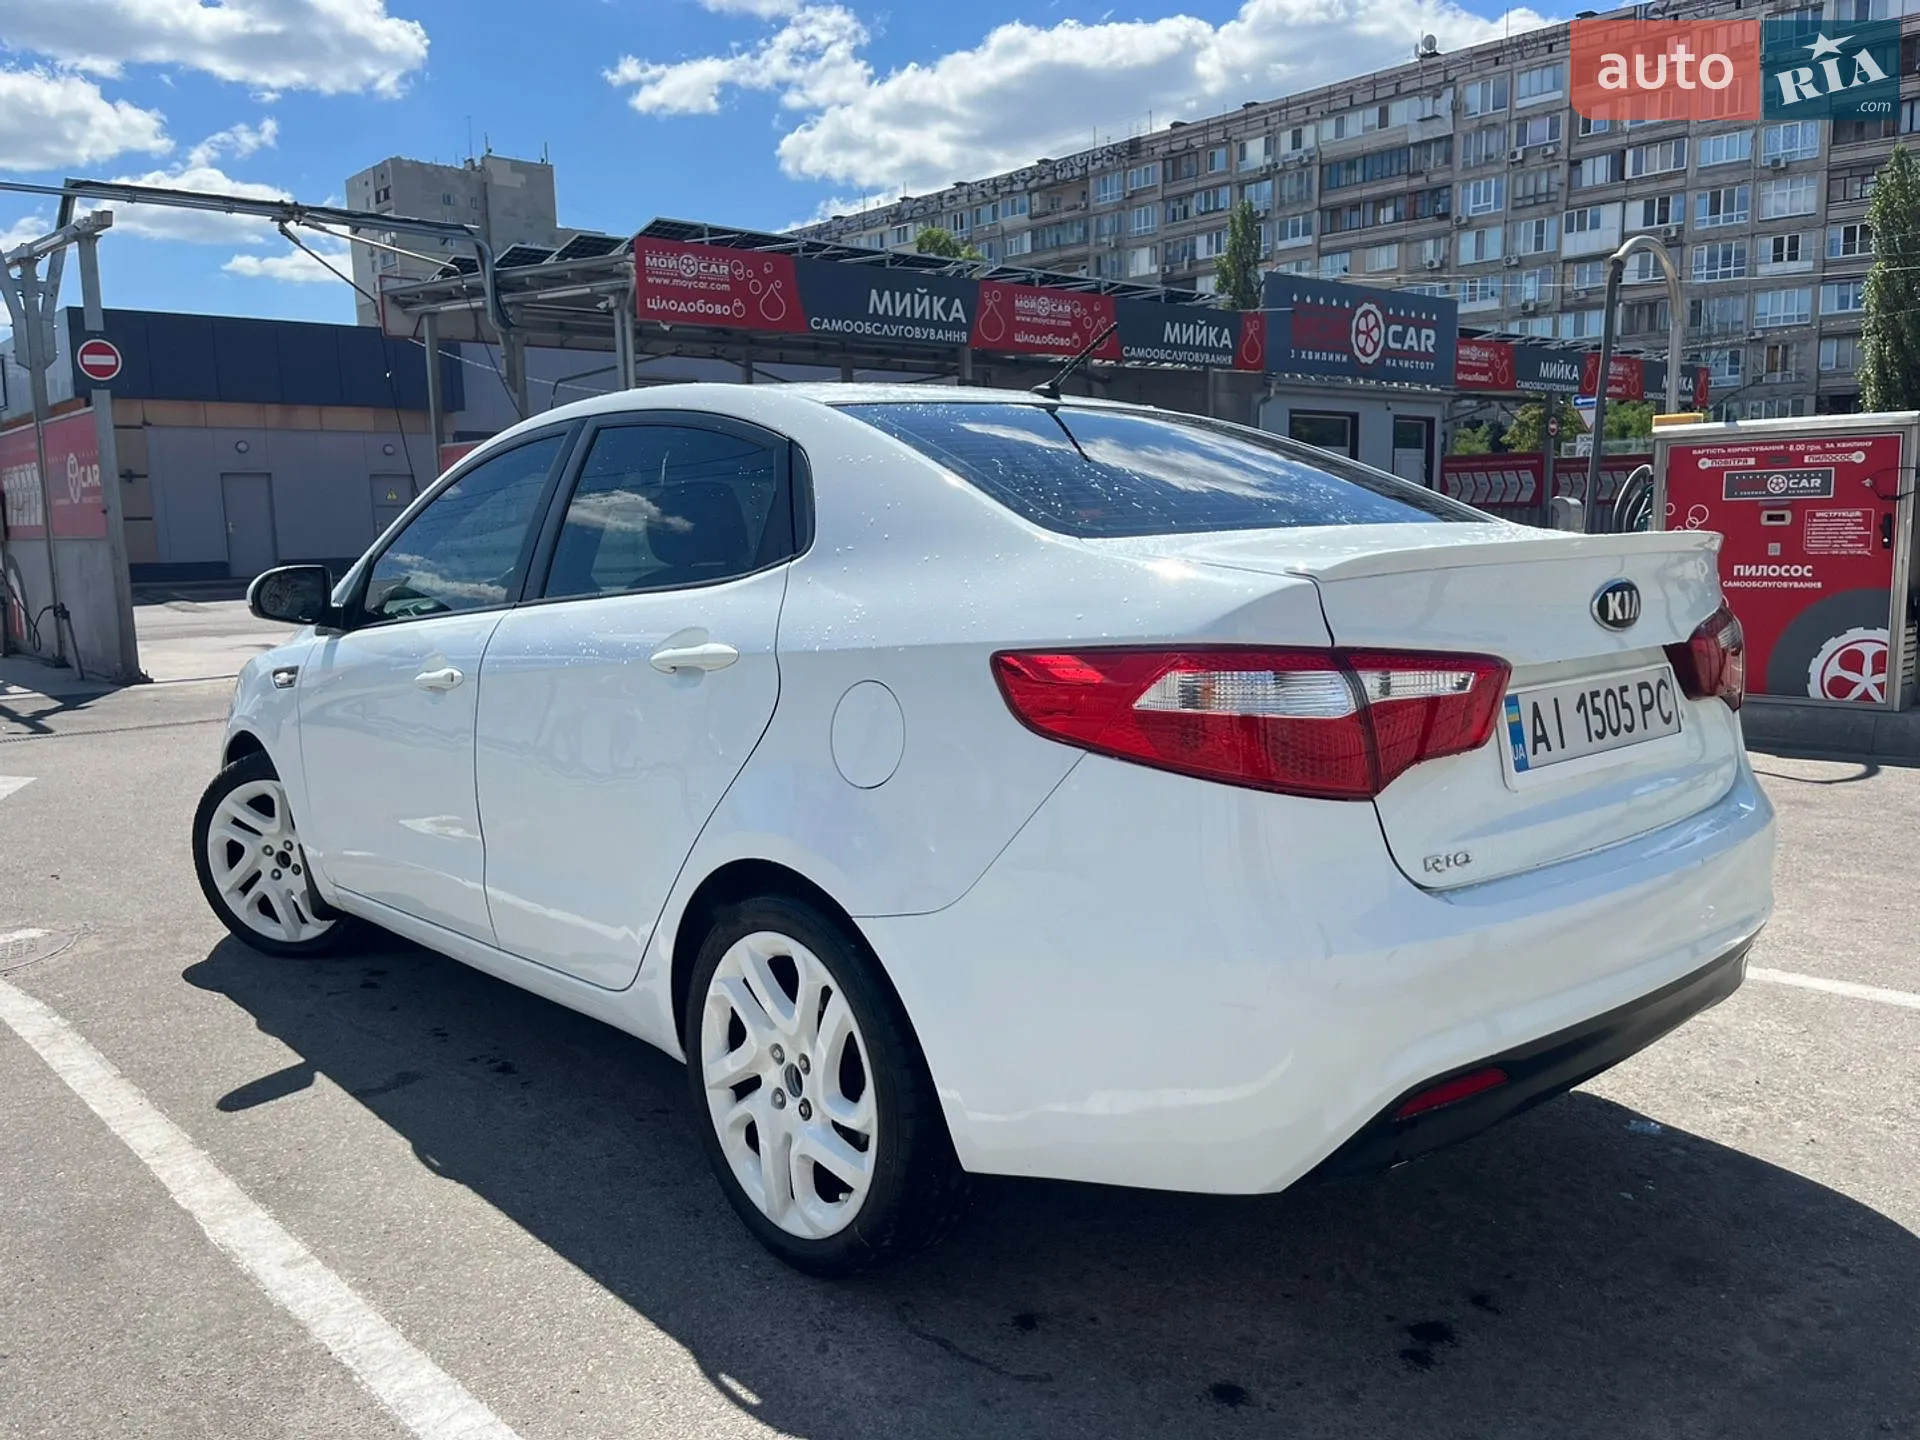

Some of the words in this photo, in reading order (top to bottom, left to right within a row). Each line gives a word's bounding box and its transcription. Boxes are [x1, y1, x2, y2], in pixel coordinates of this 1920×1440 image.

[699, 262, 730, 275] CAR
[646, 276, 731, 292] www.moycar.com
[868, 287, 967, 324] МИЙКА
[810, 316, 968, 344] САМООБСЛУГОВУВАННЯ
[1163, 319, 1233, 349] МИЙКА
[1387, 324, 1437, 353] CAR
[1122, 345, 1233, 366] САМООБСЛУГОВУВАННЯ
[1539, 359, 1580, 381] МИЙКА
[1807, 454, 1853, 463] ПИЛОСОС
[80, 463, 101, 488] CAR
[1788, 478, 1822, 489] CAR
[1733, 564, 1814, 578] ПИЛОСОС
[1722, 580, 1823, 590] САМООБСЛУГОВУВАННЯ
[1606, 590, 1640, 621] KIA
[1575, 684, 1636, 744] 1505
[1636, 677, 1673, 731] PC
[1511, 743, 1528, 760] UA
[1422, 851, 1472, 873] RIO
